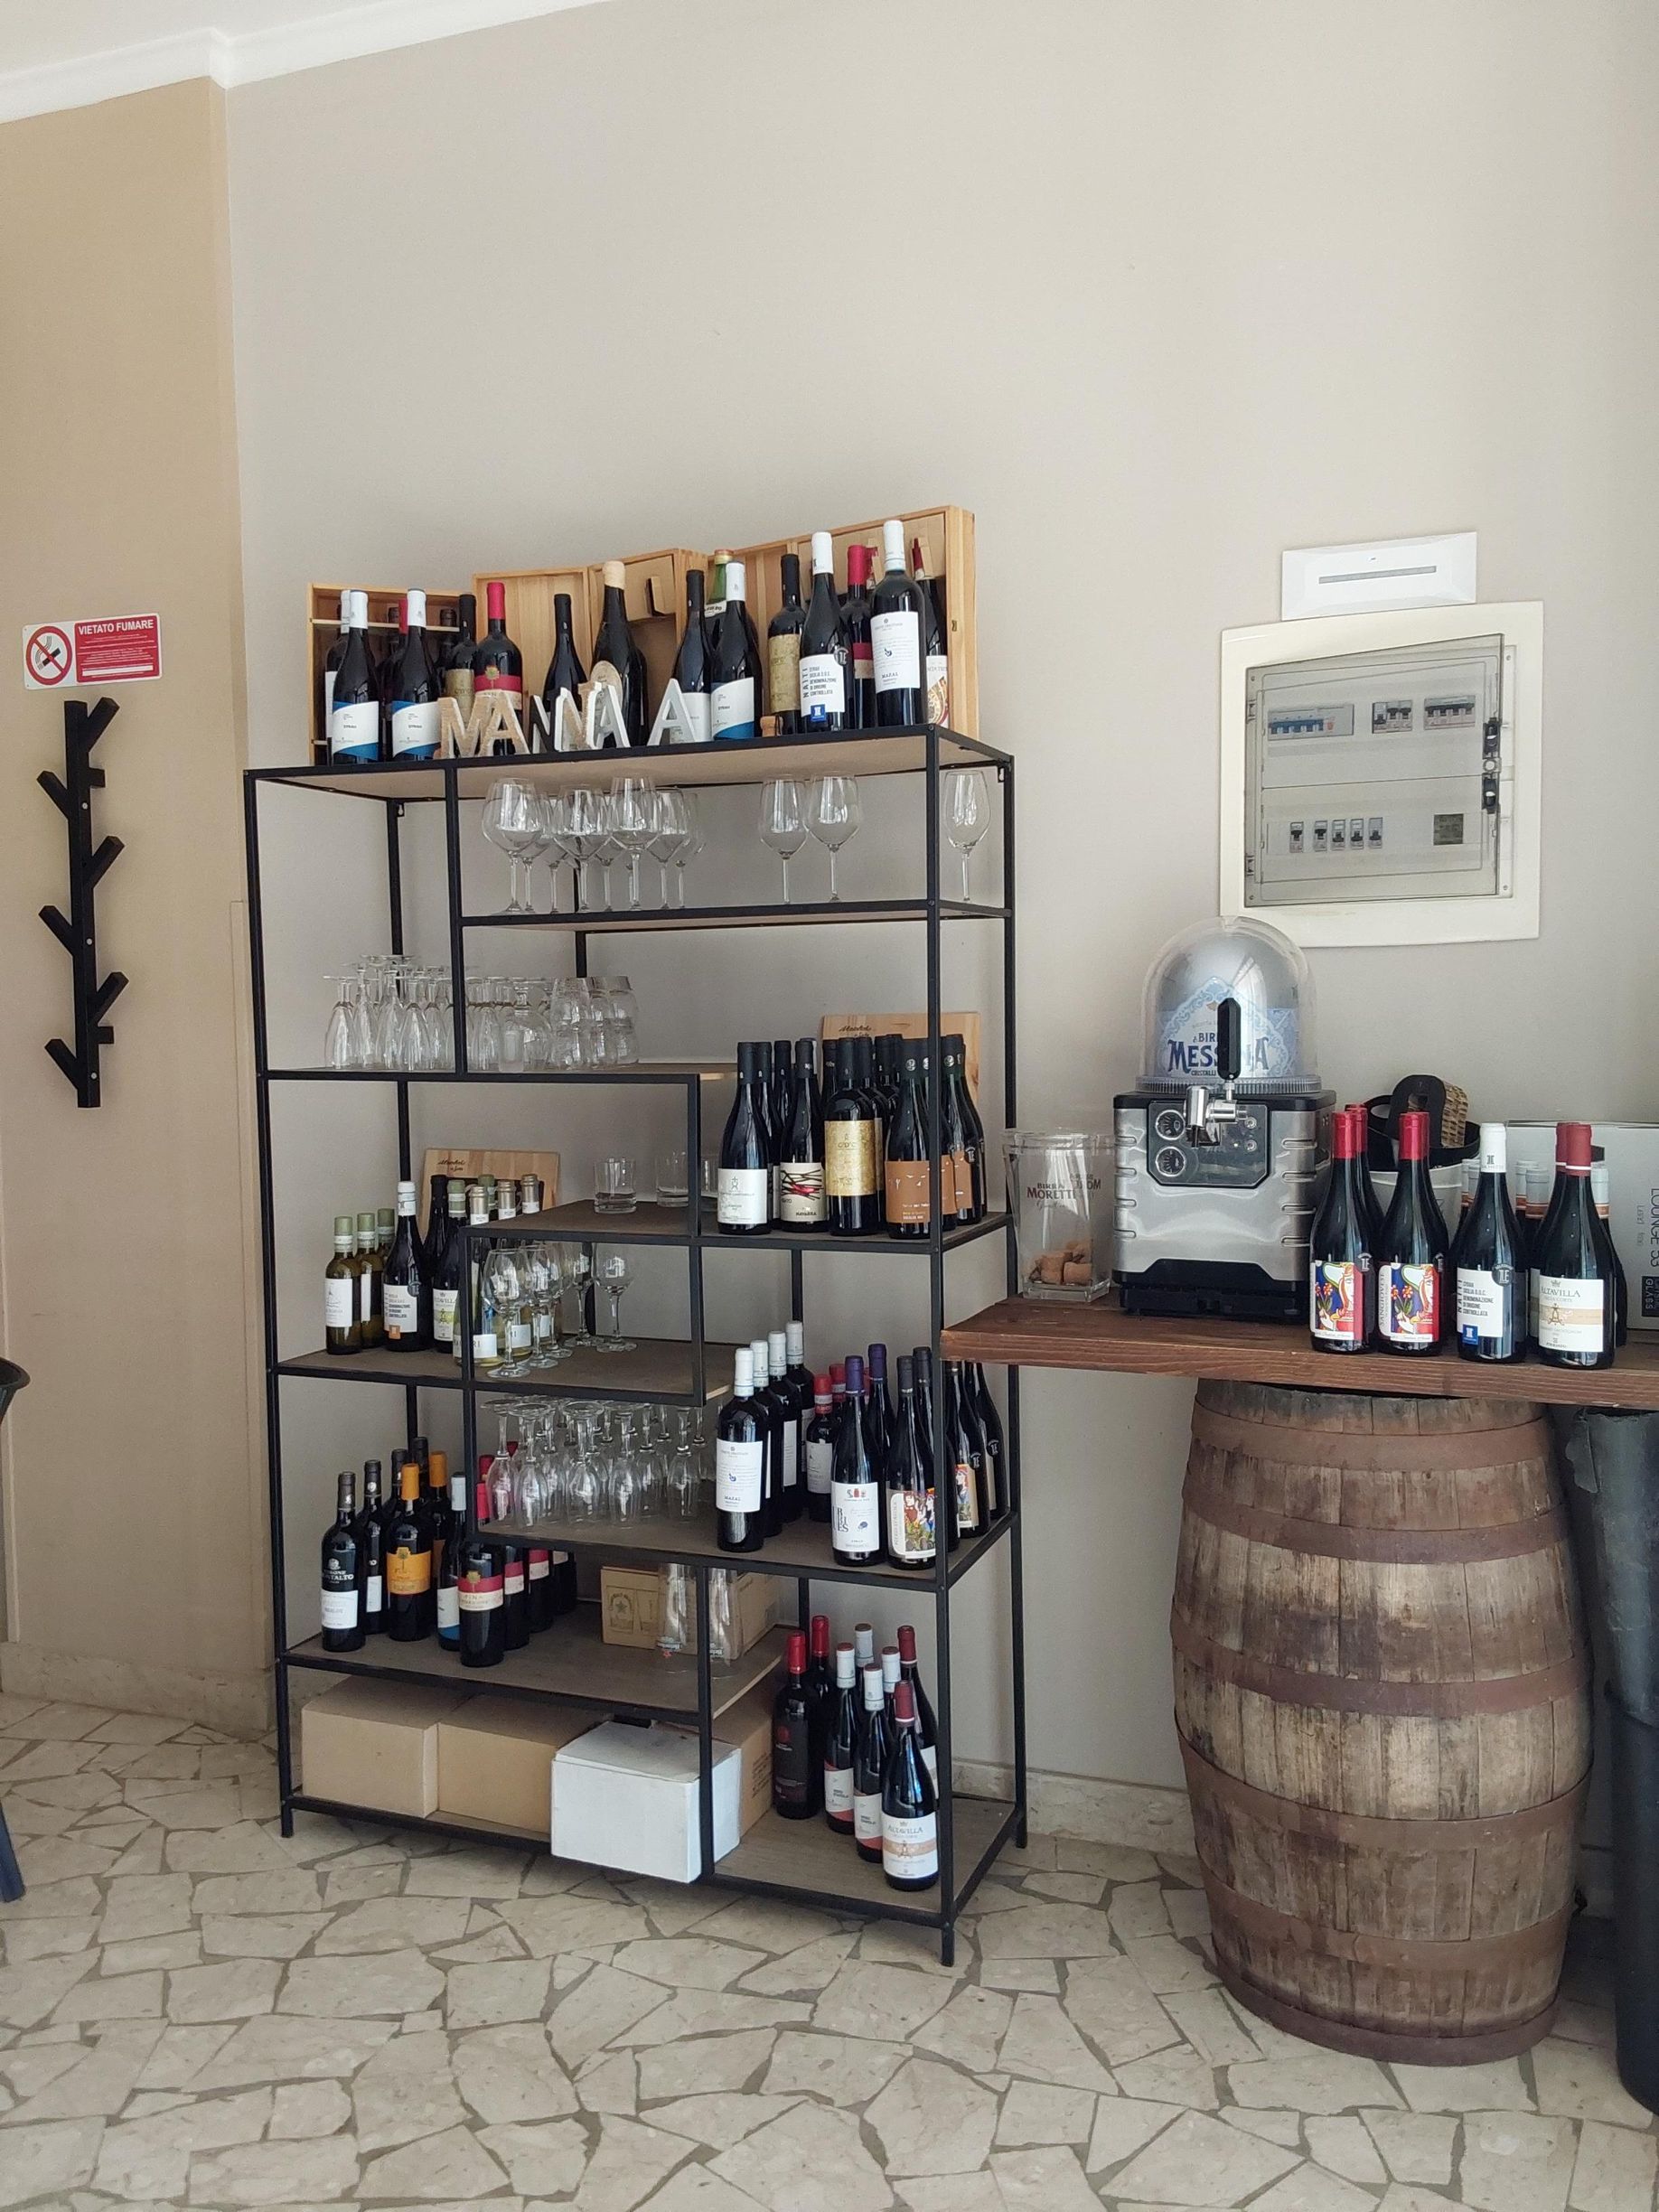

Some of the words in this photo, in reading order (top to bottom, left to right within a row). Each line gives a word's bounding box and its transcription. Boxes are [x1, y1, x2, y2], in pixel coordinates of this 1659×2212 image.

[79, 623, 115, 635] VIETATO
[117, 619, 154, 632] FUMARE
[1198, 1033, 1216, 1042] BIR
[1167, 1036, 1269, 1073] MESA
[1026, 1186, 1076, 1199] MORETTI
[1645, 1279, 1654, 1309] GLASS
[323, 1574, 354, 1582] TALTO
